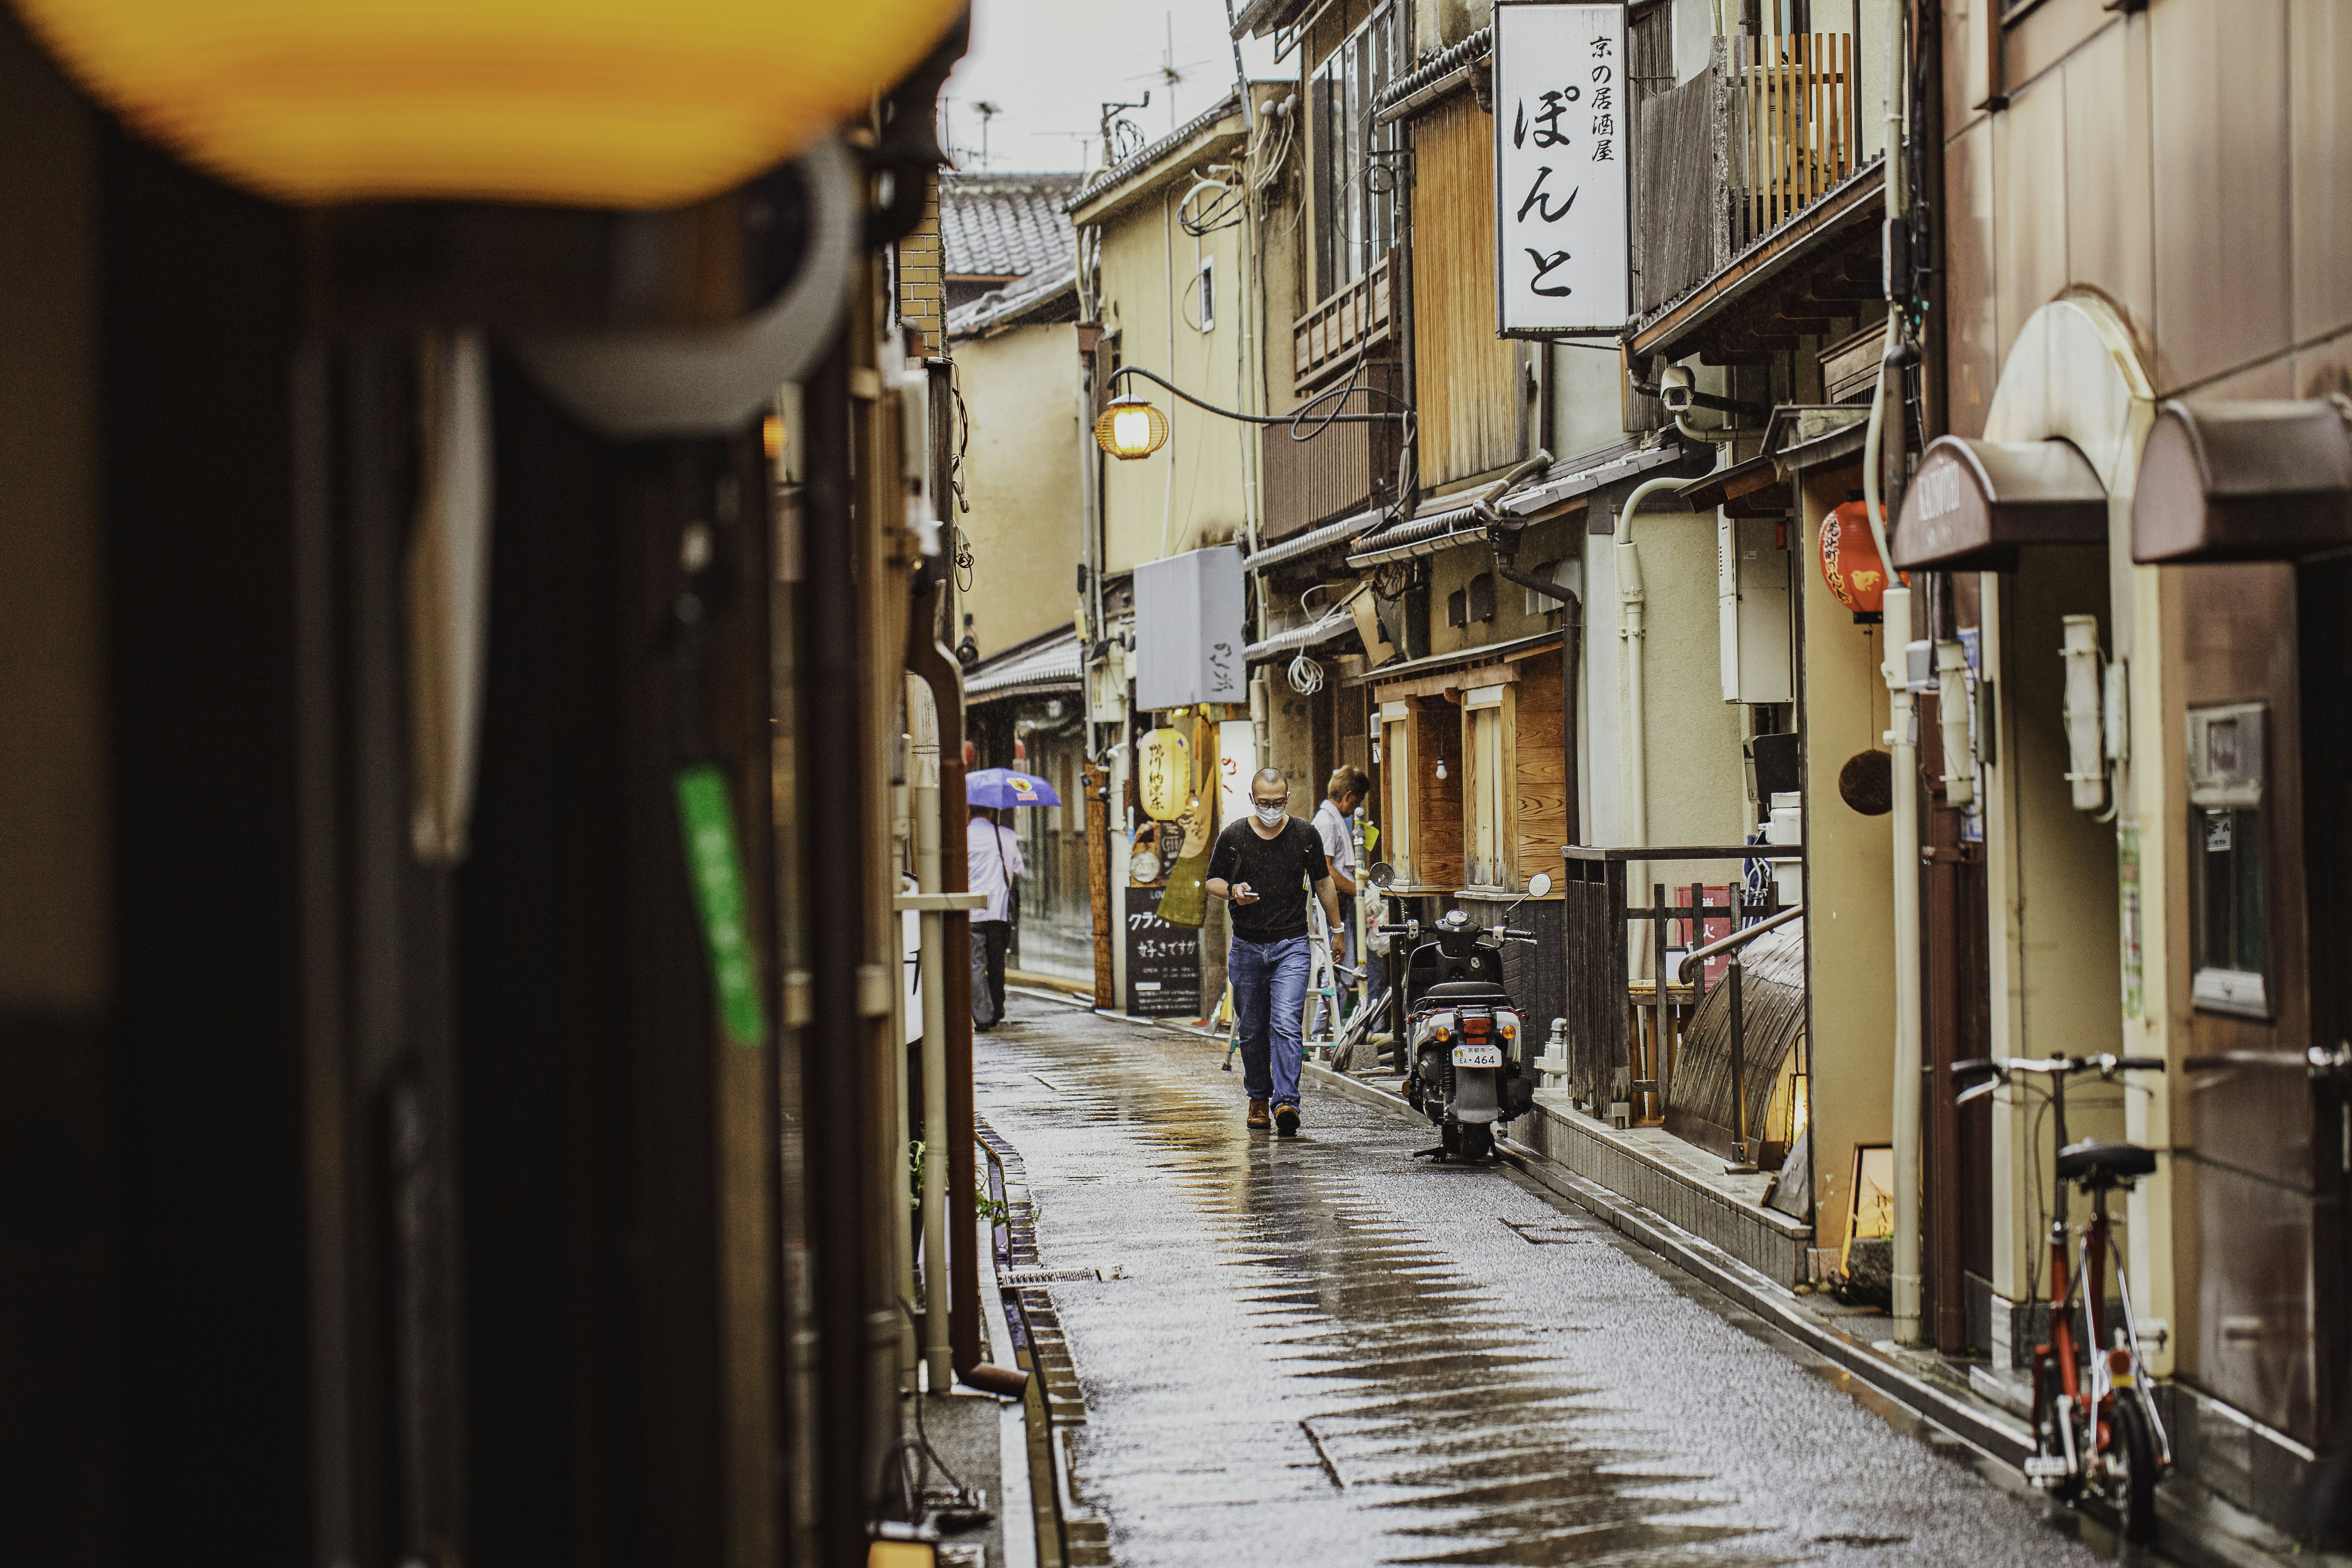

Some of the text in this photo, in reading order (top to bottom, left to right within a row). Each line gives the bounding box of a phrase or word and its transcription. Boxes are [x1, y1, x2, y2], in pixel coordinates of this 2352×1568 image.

[1590, 36, 1615, 162] 京の居酒屋
[1514, 85, 1581, 297] ぽんと
